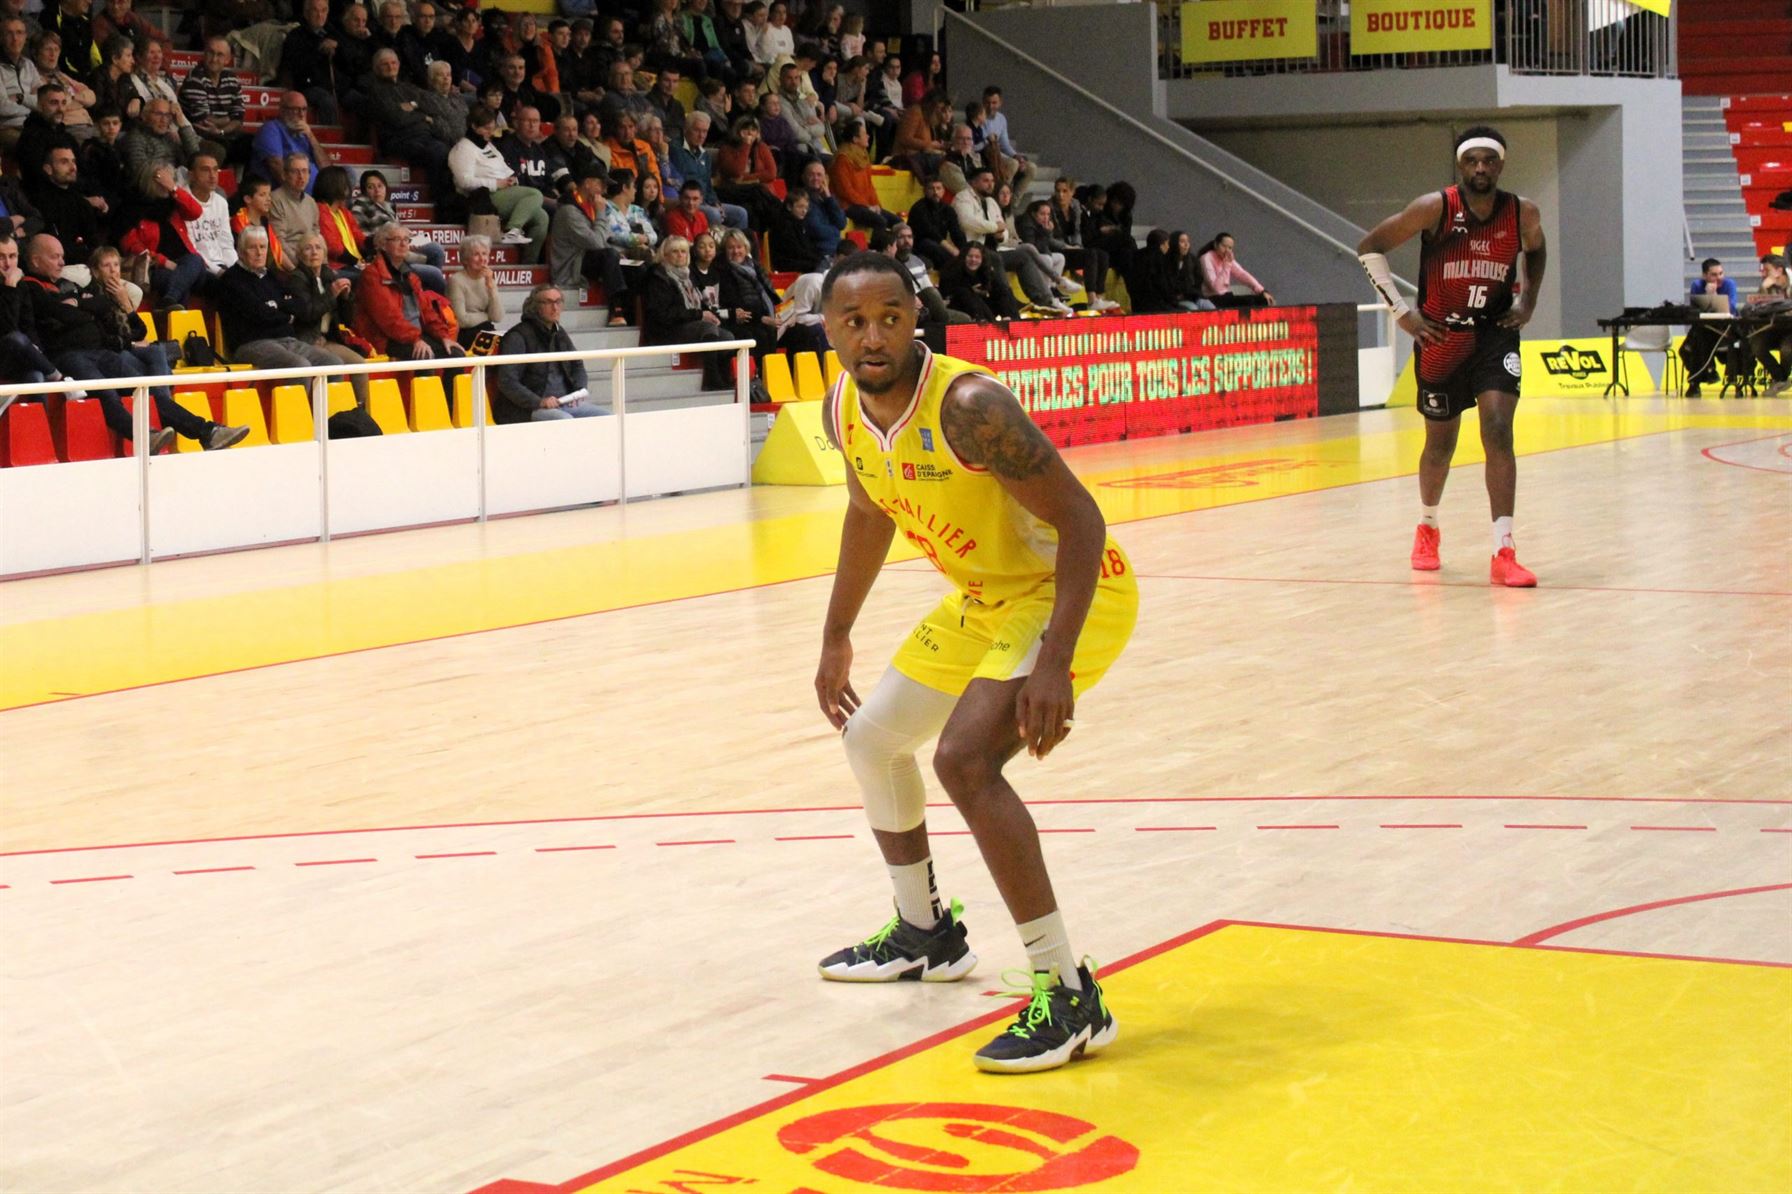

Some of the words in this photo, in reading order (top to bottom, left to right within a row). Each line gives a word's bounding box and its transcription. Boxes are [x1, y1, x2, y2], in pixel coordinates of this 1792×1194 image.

[1208, 17, 1288, 41] BUFFET
[1366, 8, 1475, 33] BOUTIQUE
[1443, 259, 1510, 282] MULHOUSE
[1467, 285, 1487, 309] 16
[1088, 361, 1133, 406] POUR
[1136, 357, 1178, 402] TOUS
[1181, 355, 1211, 397] LES
[1214, 347, 1306, 394] SUPPORTERS
